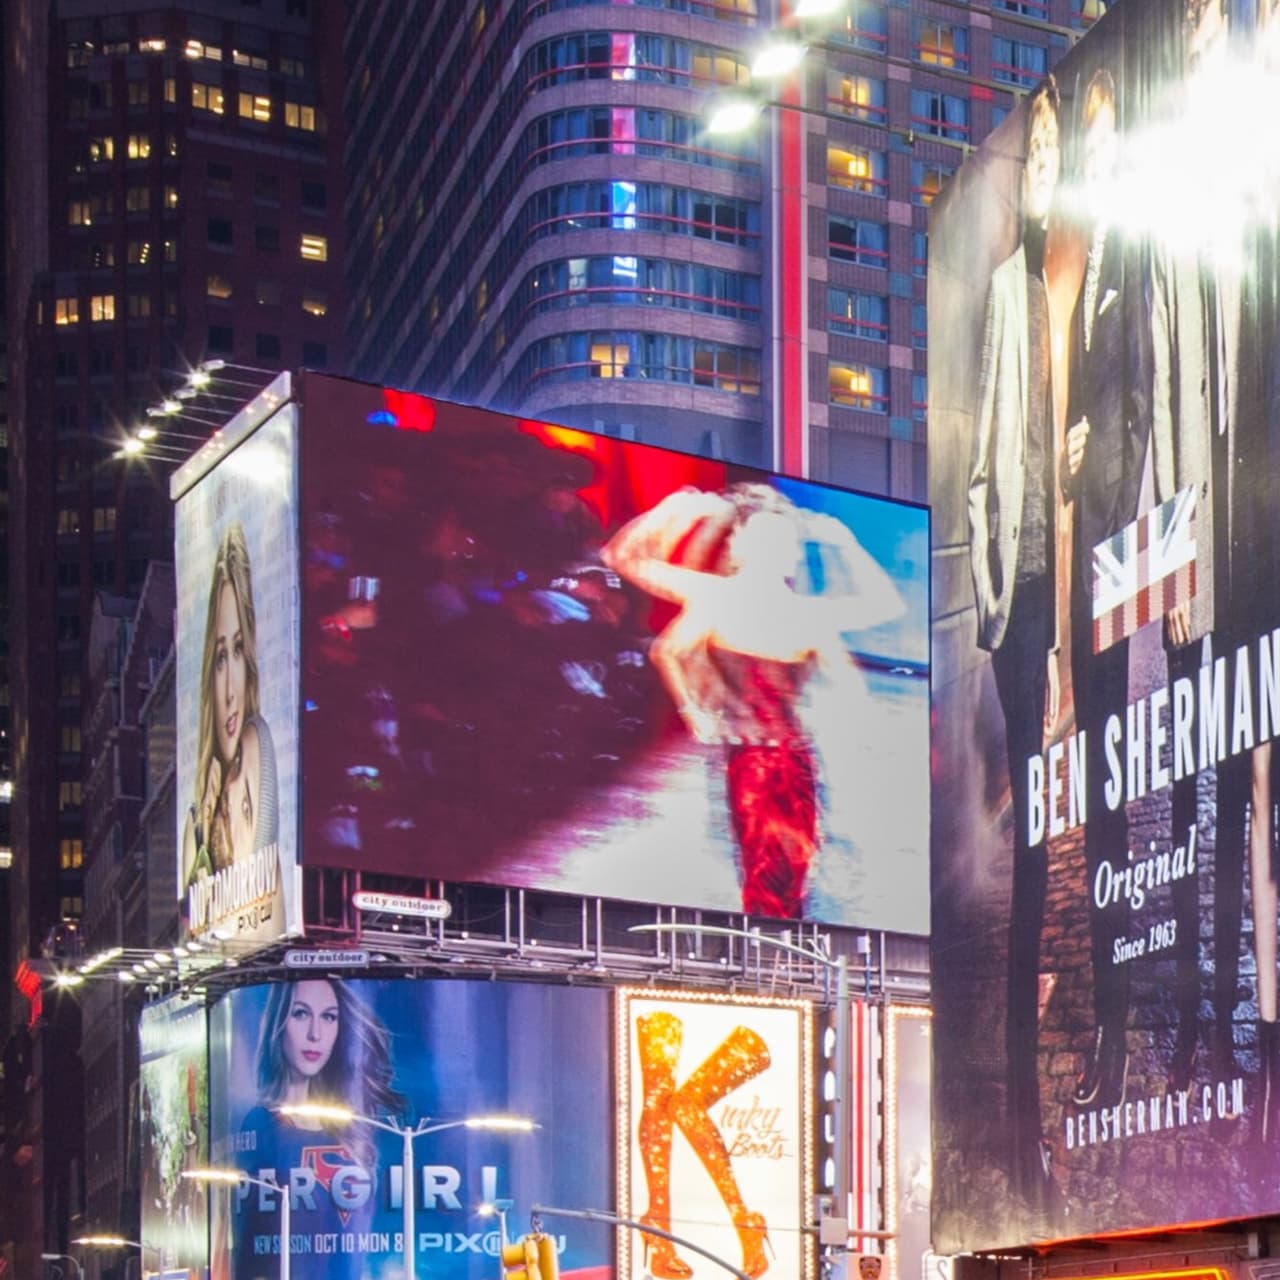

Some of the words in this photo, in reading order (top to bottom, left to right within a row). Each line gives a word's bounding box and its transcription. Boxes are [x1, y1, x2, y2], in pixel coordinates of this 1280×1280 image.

[1027, 730, 1087, 847] BEN
[1094, 824, 1196, 910] Original
[293, 952, 315, 966] city
[318, 951, 363, 964] outdoor
[1112, 935, 1145, 964] Since
[1147, 918, 1177, 951] 1963
[1066, 1077, 1244, 1150] BENSHERMAN.COM
[272, 1233, 312, 1254] SSON
[314, 1232, 338, 1253] OCT
[359, 1232, 391, 1253] MON
